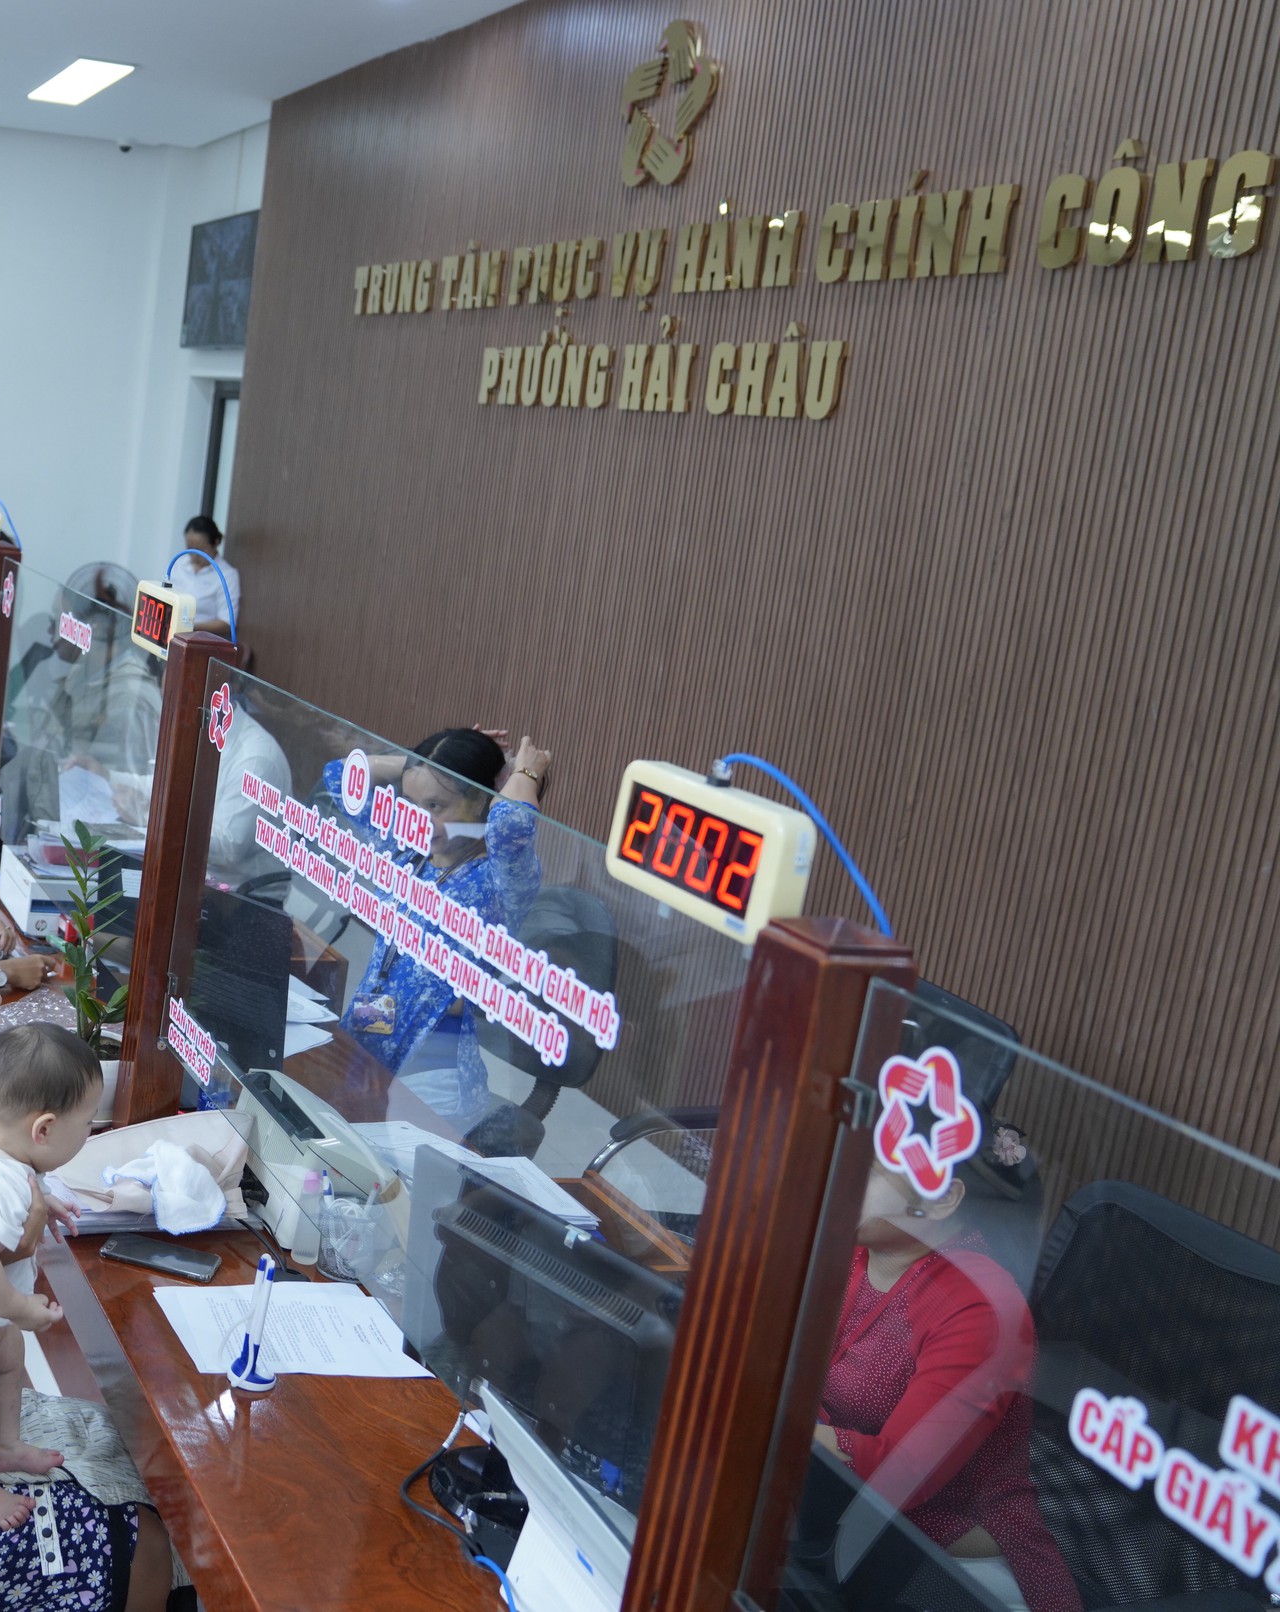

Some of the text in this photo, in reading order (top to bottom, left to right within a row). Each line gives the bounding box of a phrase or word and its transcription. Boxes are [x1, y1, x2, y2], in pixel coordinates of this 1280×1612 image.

[354, 138, 1277, 318] TRUNG TÂM PHỤC VỤ HÀNH CHÍNH CÔNG
[478, 315, 848, 420] PHƯỜNG HẢI CHÂU
[347, 764, 365, 801] 09
[373, 788, 431, 851] HỘ TỊCH:
[622, 791, 764, 910] 2002
[243, 772, 260, 801] KHAI
[261, 784, 280, 813] SINH
[284, 799, 304, 831] KHAI
[320, 819, 337, 851] KẾT
[337, 833, 358, 866] HÔN
[359, 845, 374, 875] CÓ
[375, 855, 394, 890] YẾU
[395, 867, 412, 900] TỐ
[410, 879, 441, 920] NƯỚC
[485, 928, 522, 978] ĐĂNG
[524, 954, 545, 990] KÝ
[546, 969, 586, 1019] GIÁM
[257, 818, 275, 848] THAY
[291, 840, 306, 872] CẢI
[337, 872, 354, 903] BỔ
[352, 886, 379, 925] SUNG
[380, 904, 395, 940] HỘ
[424, 937, 449, 975] XÁC
[450, 954, 481, 998] ĐỊNH
[482, 977, 504, 1016] LẠI
[505, 994, 535, 1039] DÂN
[536, 1018, 565, 1059] TỘC
[1078, 1401, 1268, 1559] CẤP GIẤY
